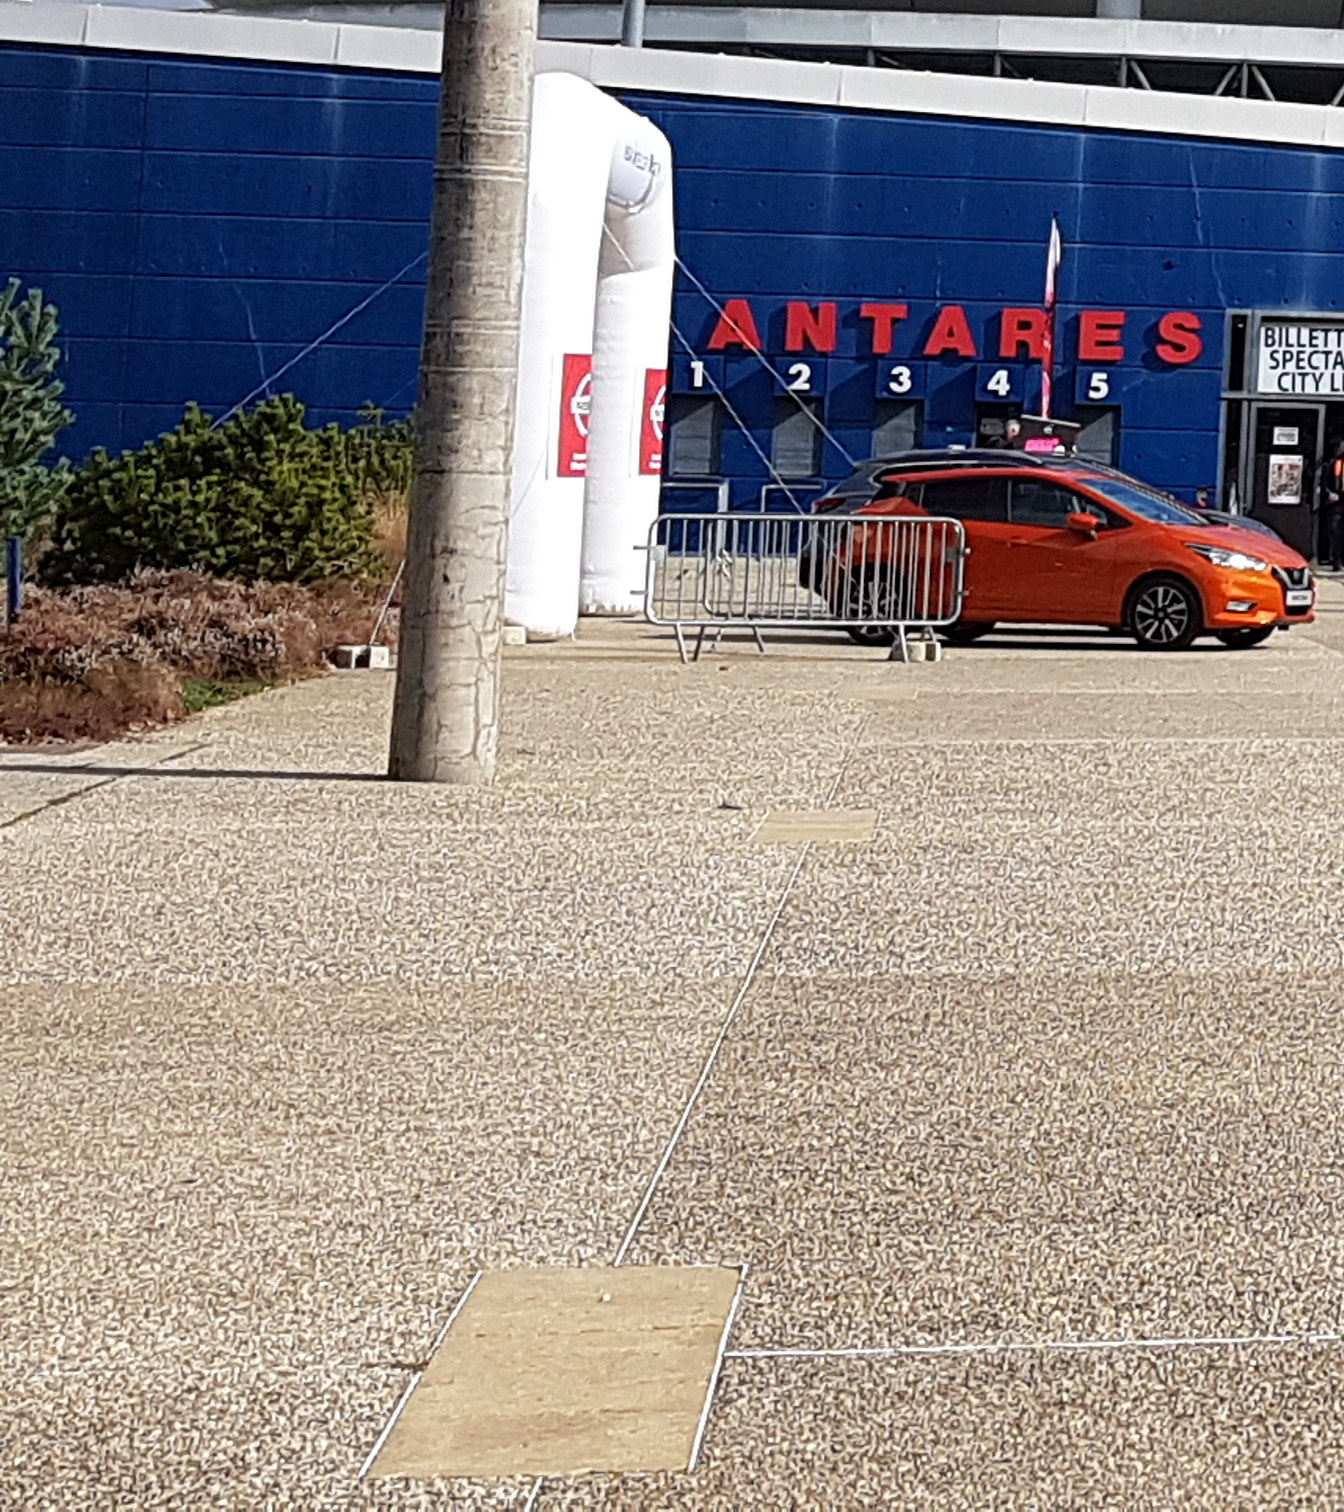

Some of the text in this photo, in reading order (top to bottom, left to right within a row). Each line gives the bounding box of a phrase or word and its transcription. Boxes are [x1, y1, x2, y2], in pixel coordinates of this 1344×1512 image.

[706, 298, 1203, 364] ANTARES
[690, 360, 1109, 399] 1 2 3 4 5
[1276, 371, 1325, 393] CITY
